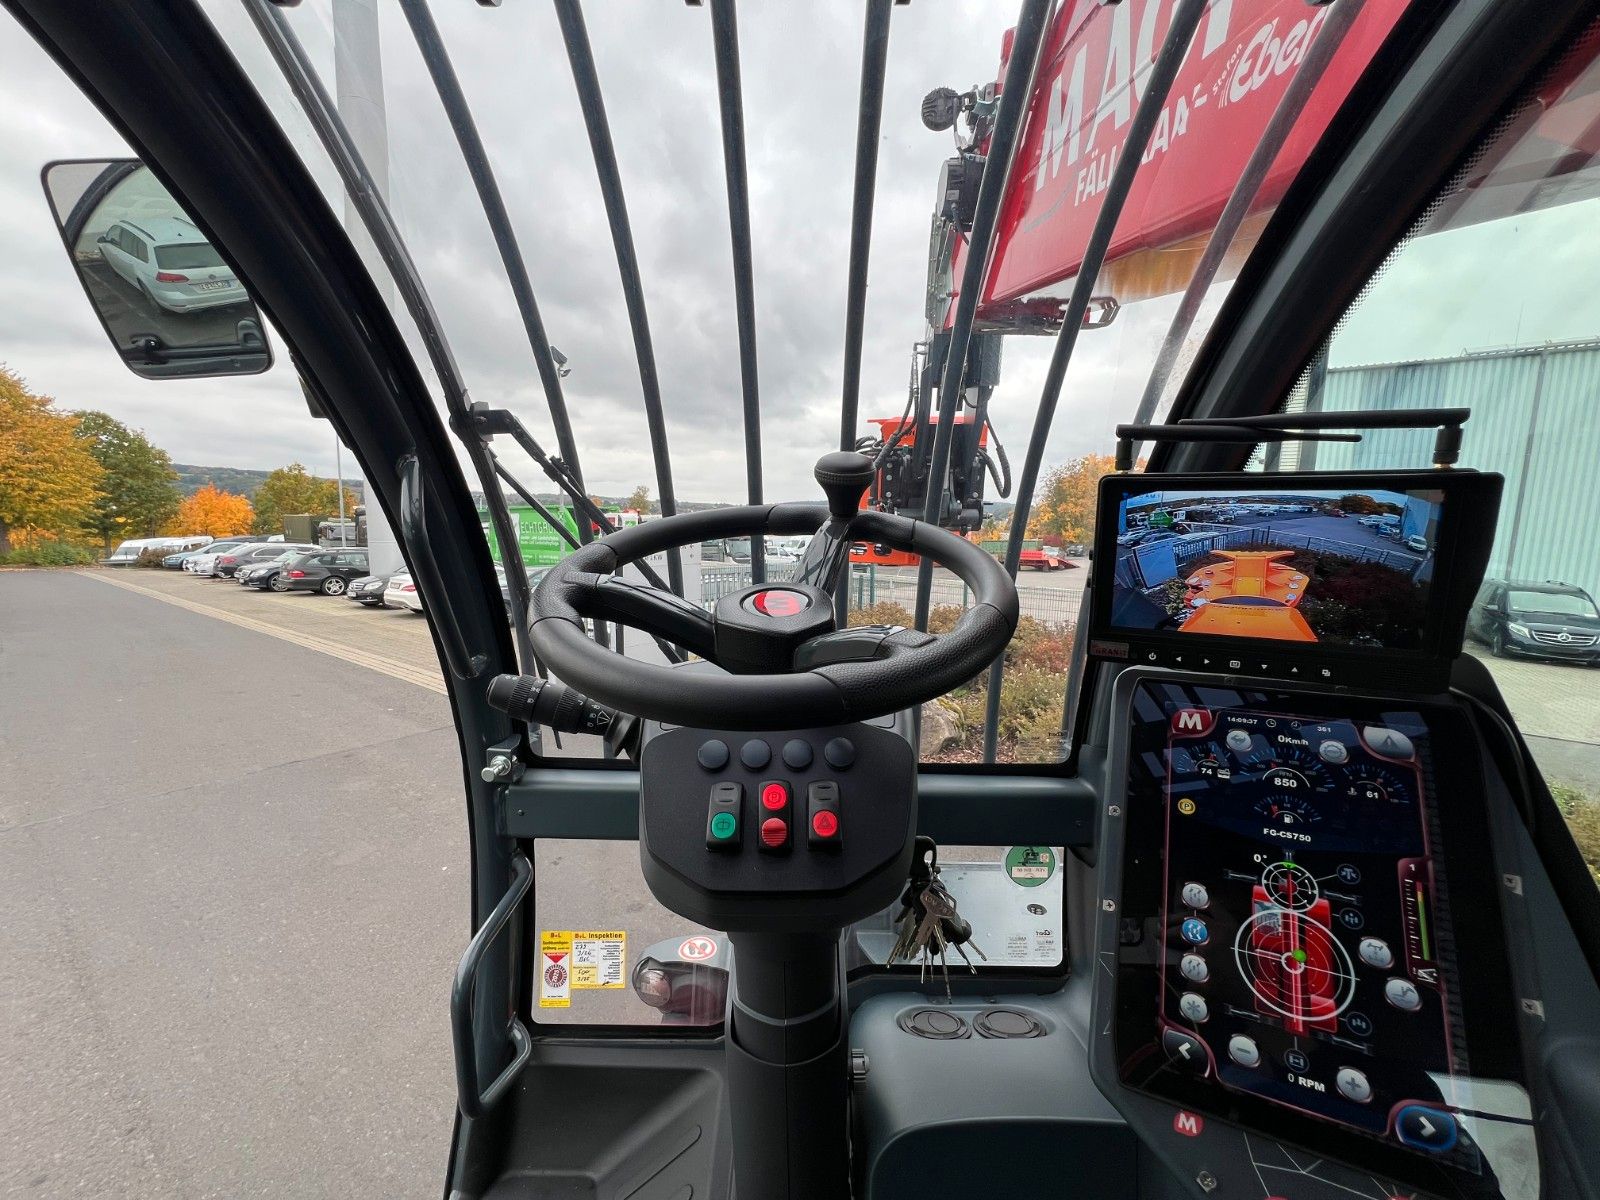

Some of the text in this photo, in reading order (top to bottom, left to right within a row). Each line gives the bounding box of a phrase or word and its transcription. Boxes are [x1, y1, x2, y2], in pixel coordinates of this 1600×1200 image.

[1178, 712, 1202, 730] M
[1201, 767, 1213, 776] 74
[1274, 777, 1297, 788] 850
[1366, 790, 1379, 799] 61
[1263, 828, 1311, 842] FG-CS750
[1287, 1073, 1325, 1092] 0 RPM
